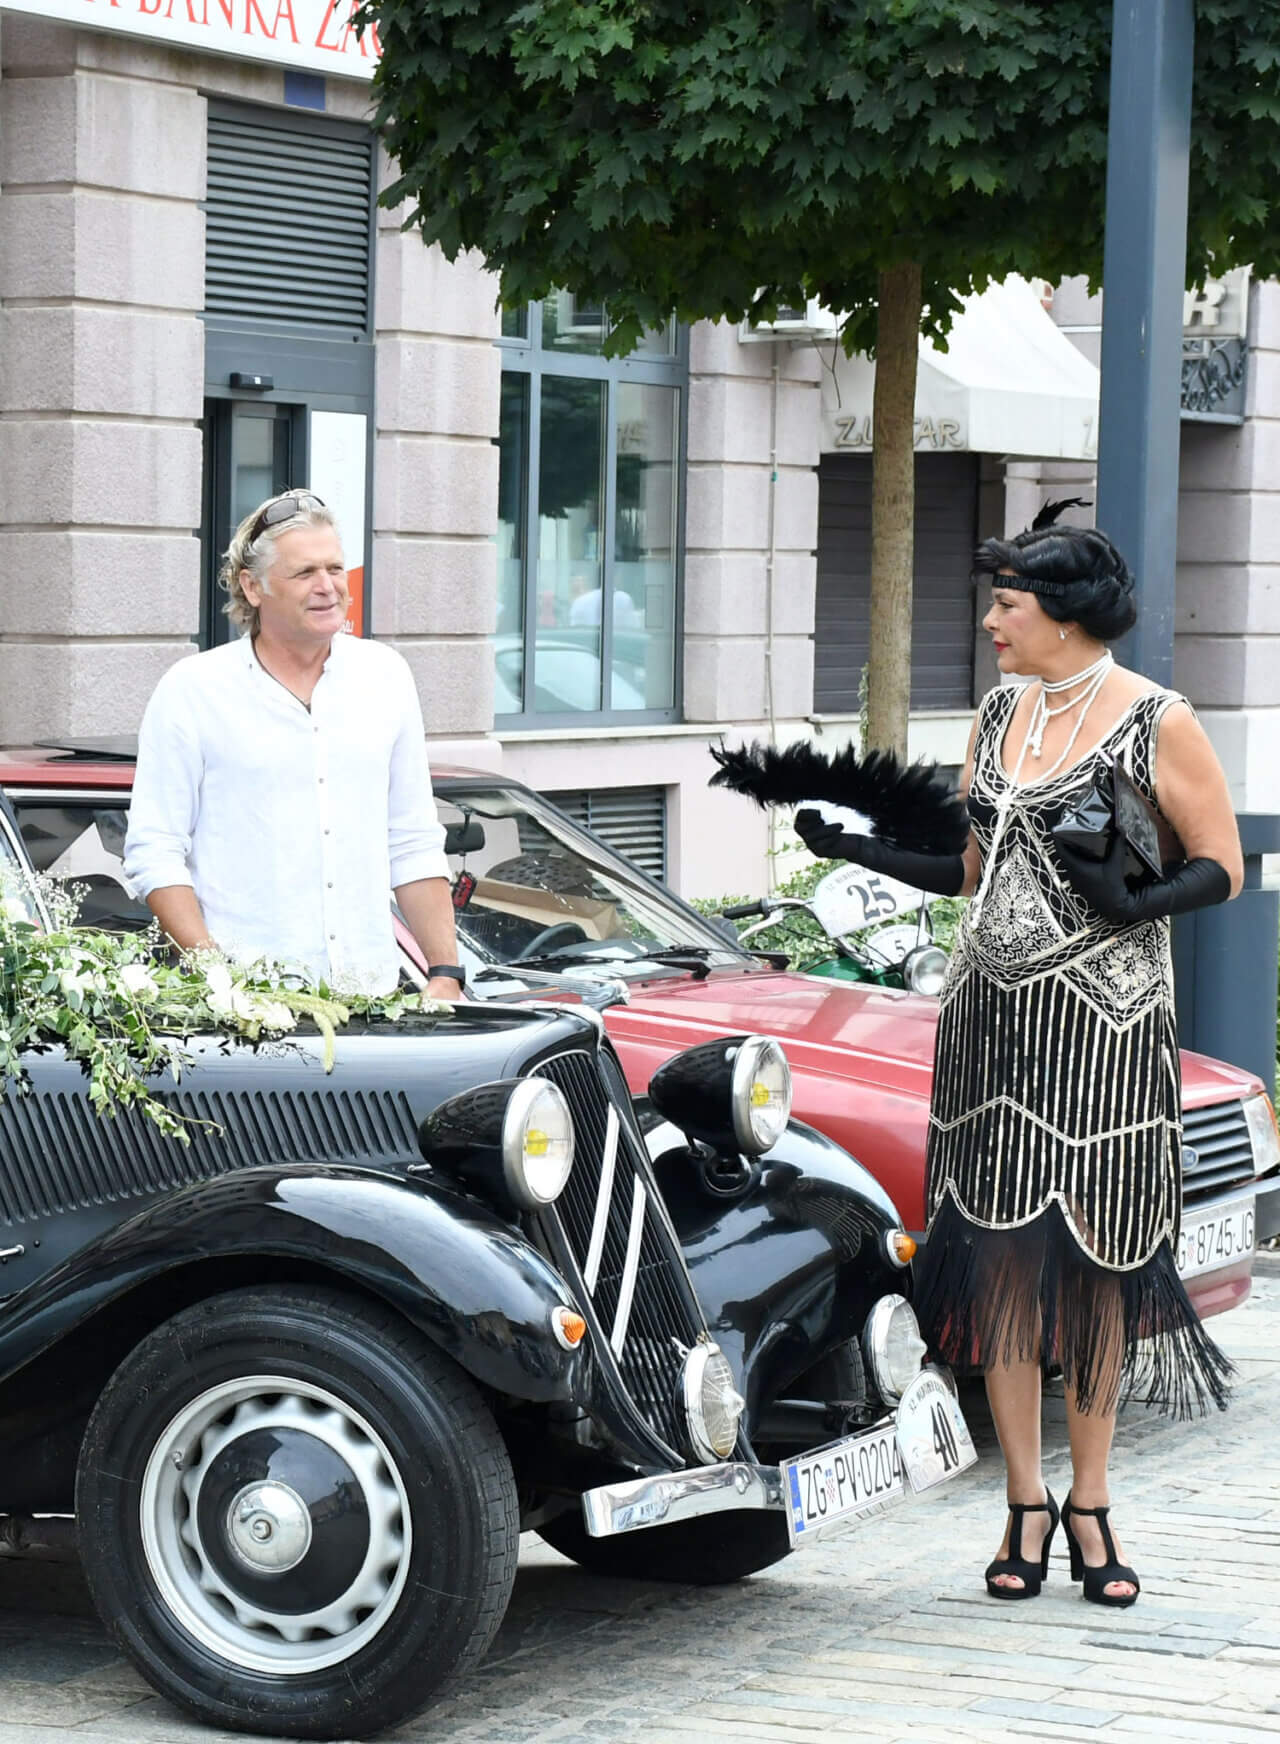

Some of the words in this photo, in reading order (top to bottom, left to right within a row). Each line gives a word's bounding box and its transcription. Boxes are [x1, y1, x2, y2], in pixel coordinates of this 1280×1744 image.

[846, 877, 897, 921] 25
[929, 1401, 960, 1473] 40
[801, 1463, 827, 1520] ZG
